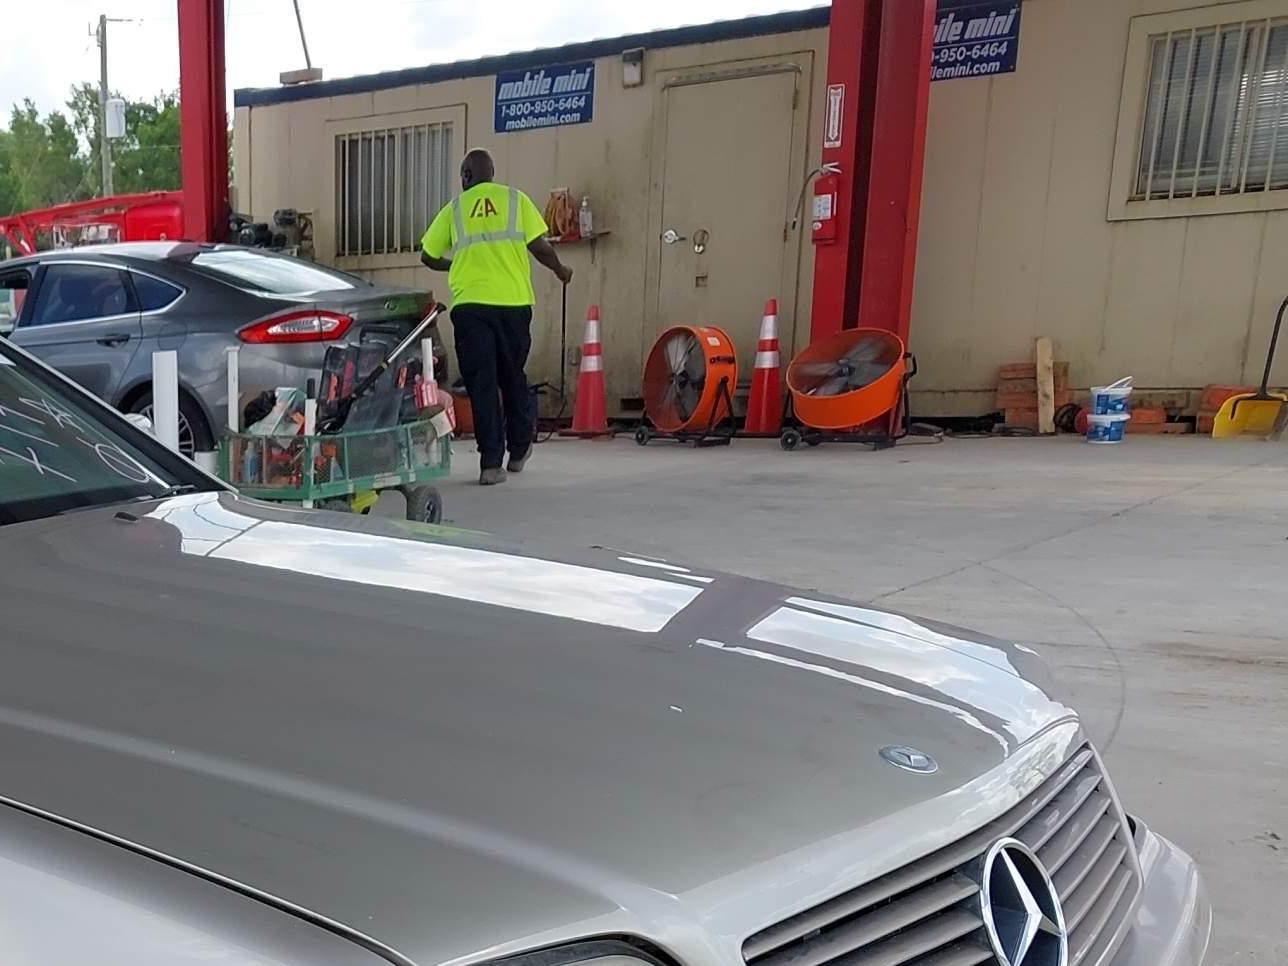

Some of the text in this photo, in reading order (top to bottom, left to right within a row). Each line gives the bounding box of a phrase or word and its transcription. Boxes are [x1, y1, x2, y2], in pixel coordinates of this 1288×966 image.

[933, 8, 1017, 43] ile mini
[498, 67, 592, 99] mobile mini
[501, 96, 586, 117] 1-800-950-6464
[505, 112, 581, 130] mobilemini.com
